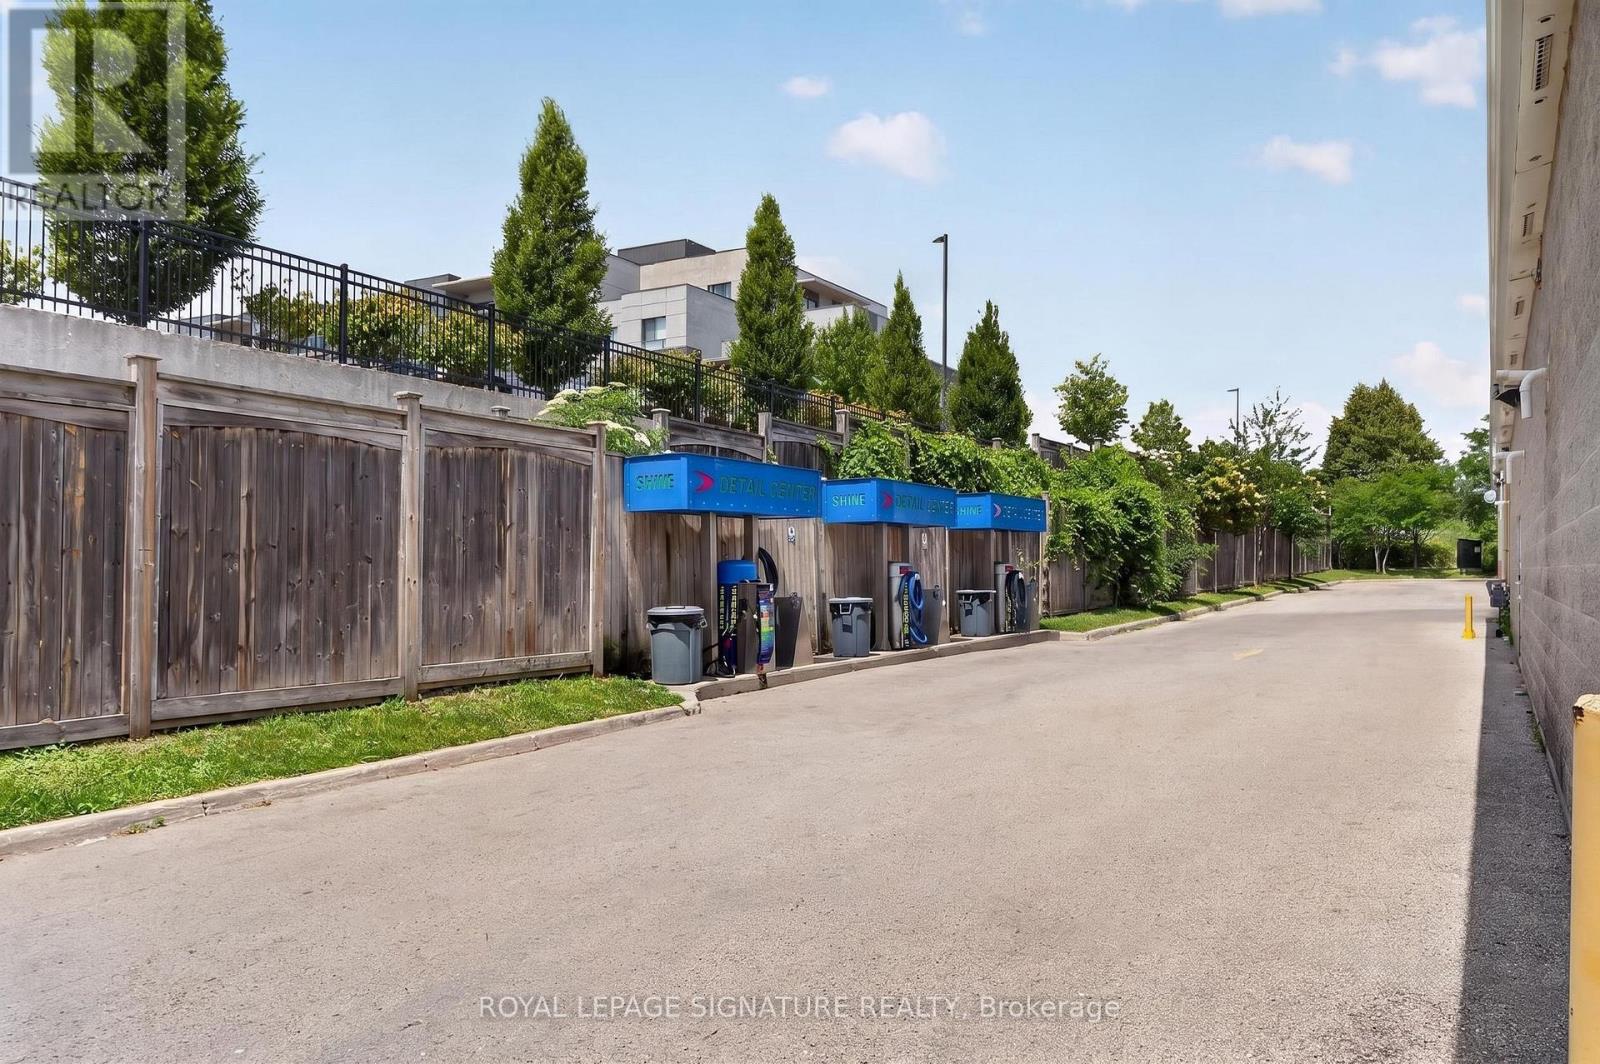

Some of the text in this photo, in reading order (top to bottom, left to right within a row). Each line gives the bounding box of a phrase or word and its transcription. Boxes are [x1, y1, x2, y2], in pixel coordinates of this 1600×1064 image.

[635, 473, 675, 491] SHINE
[719, 475, 816, 501] DETAIL CENTER
[831, 493, 866, 507] SHINE
